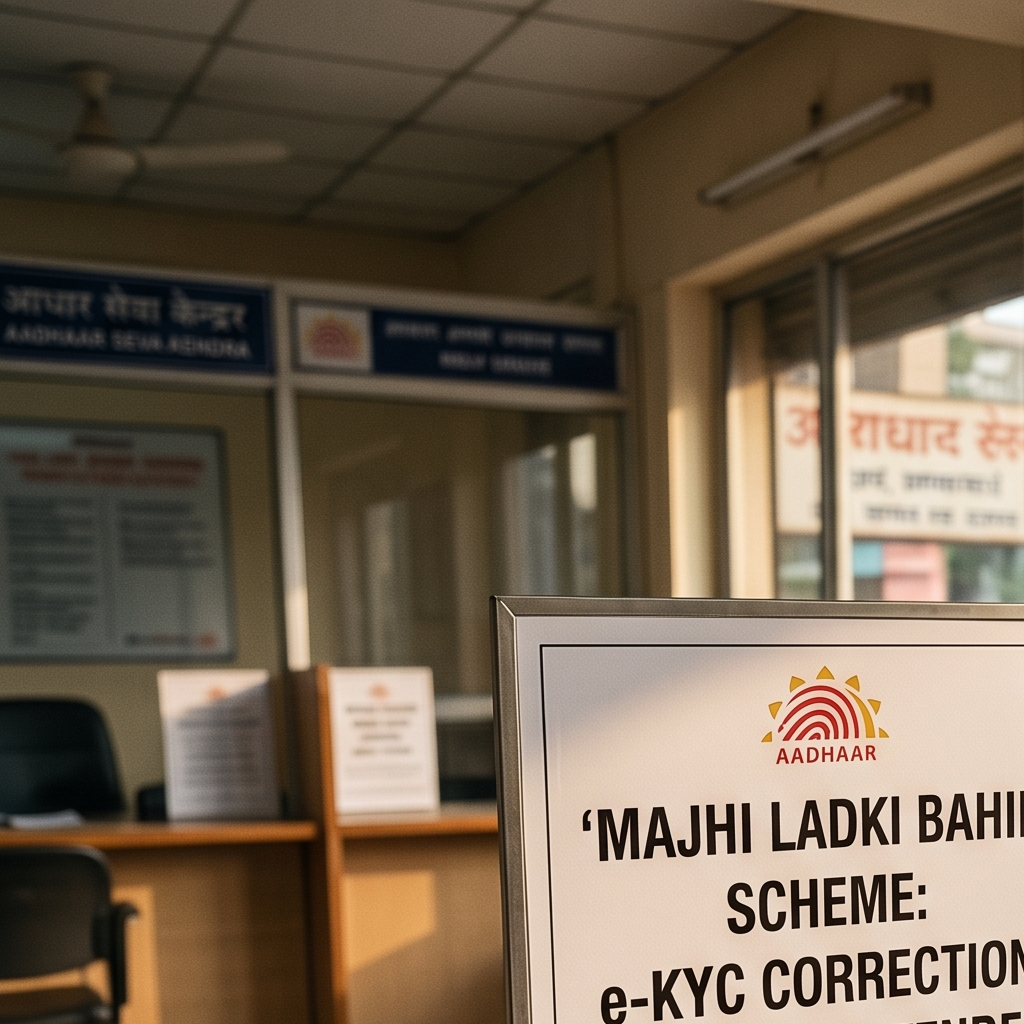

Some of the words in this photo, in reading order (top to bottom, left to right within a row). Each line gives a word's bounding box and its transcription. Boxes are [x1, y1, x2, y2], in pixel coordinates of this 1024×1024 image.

[776, 745, 877, 765] AADHAAR
[772, 796, 900, 852] LADKI
[727, 872, 927, 935] SCHEME:
